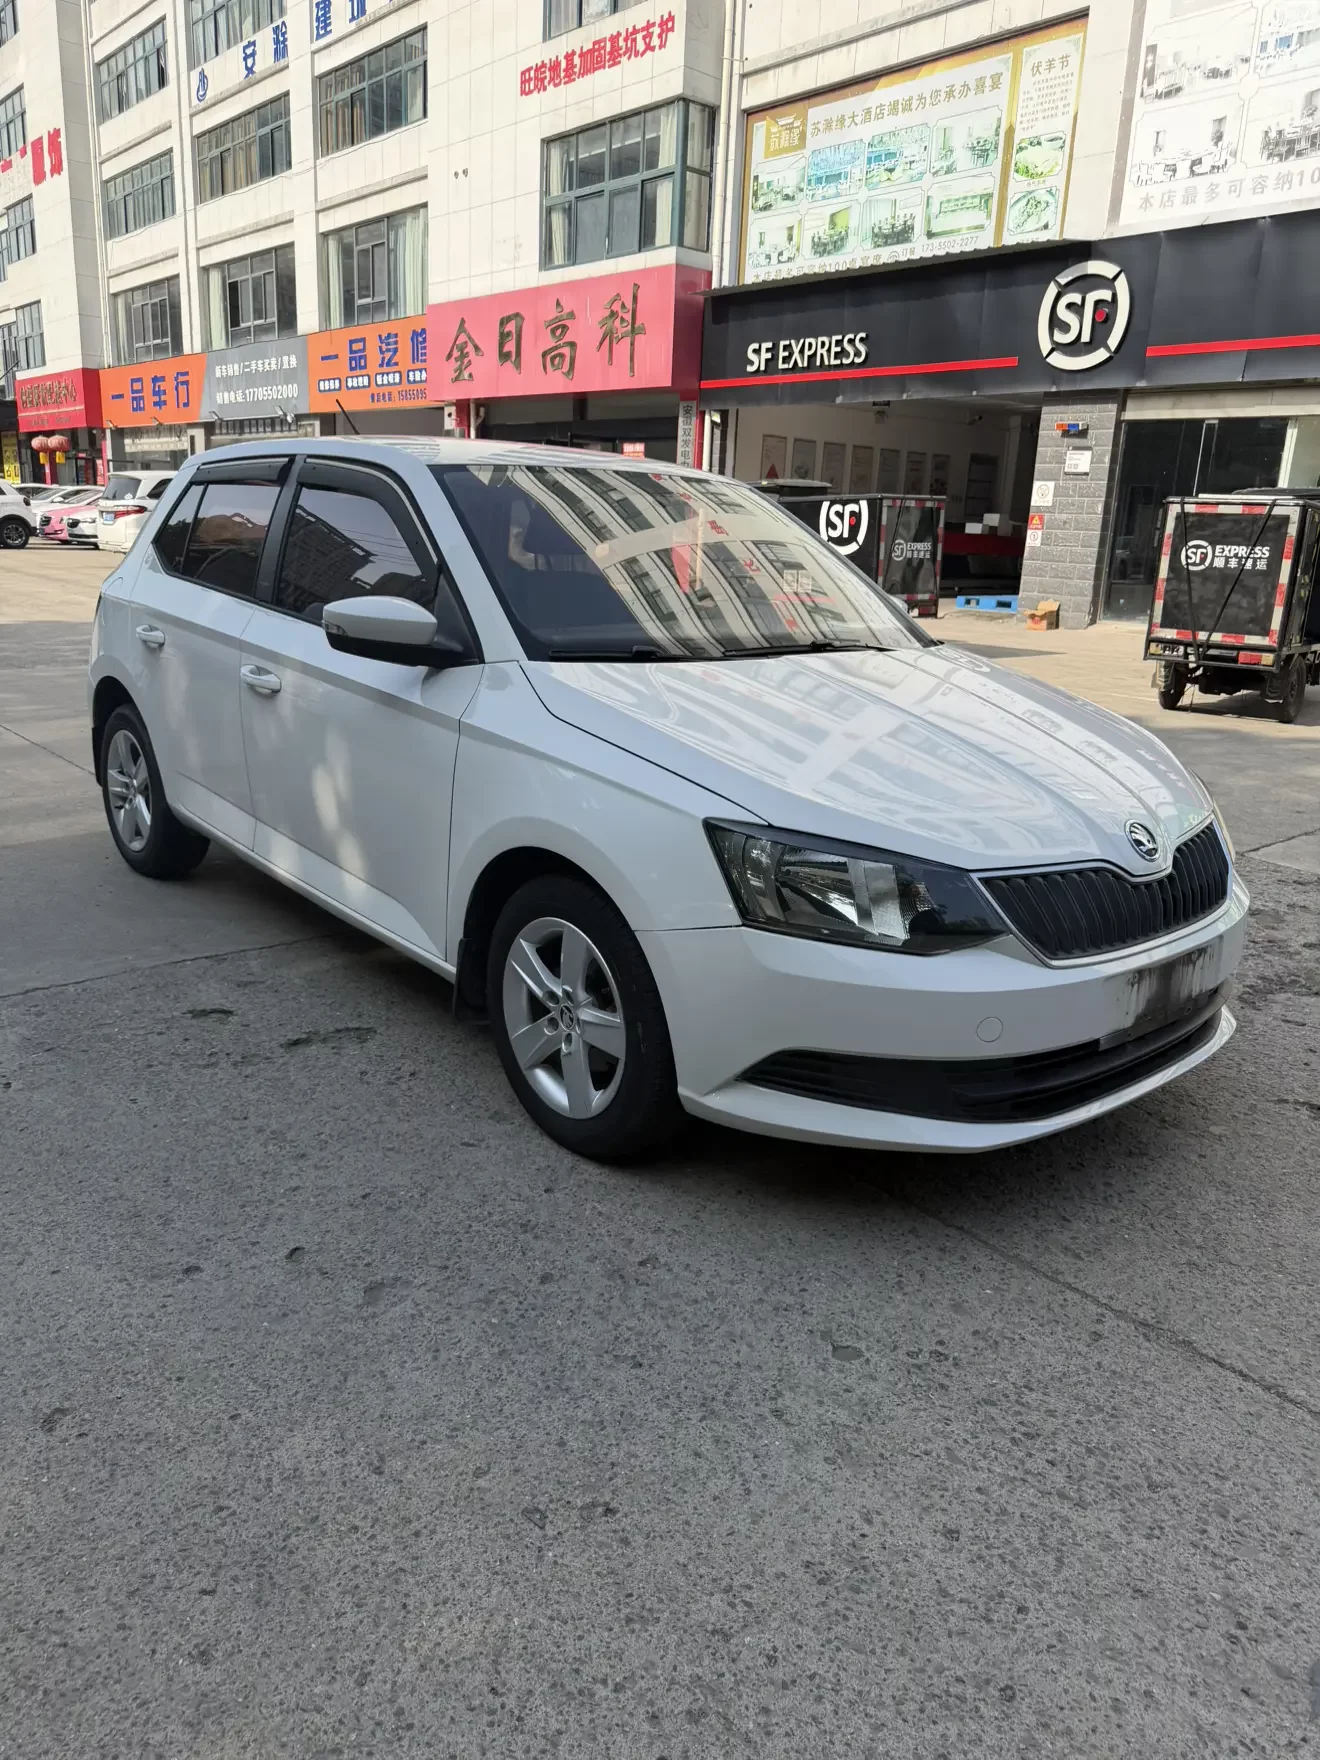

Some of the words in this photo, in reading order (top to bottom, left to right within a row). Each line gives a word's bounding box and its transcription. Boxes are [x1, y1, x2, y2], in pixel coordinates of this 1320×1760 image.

[519, 10, 675, 97] 旺皖地基加固基坑支护
[1030, 53, 1071, 77] 伏羊节
[320, 328, 427, 372] 一品汽修
[445, 282, 647, 385] 金日高科
[746, 341, 773, 373] SF
[778, 332, 867, 370] EXPRESS
[111, 370, 190, 413] 一品车行
[827, 503, 860, 538] SF
[907, 542, 932, 550] EXPRESS
[1212, 557, 1268, 570] 顺丰速运
[1214, 545, 1270, 558] EXPRESS
